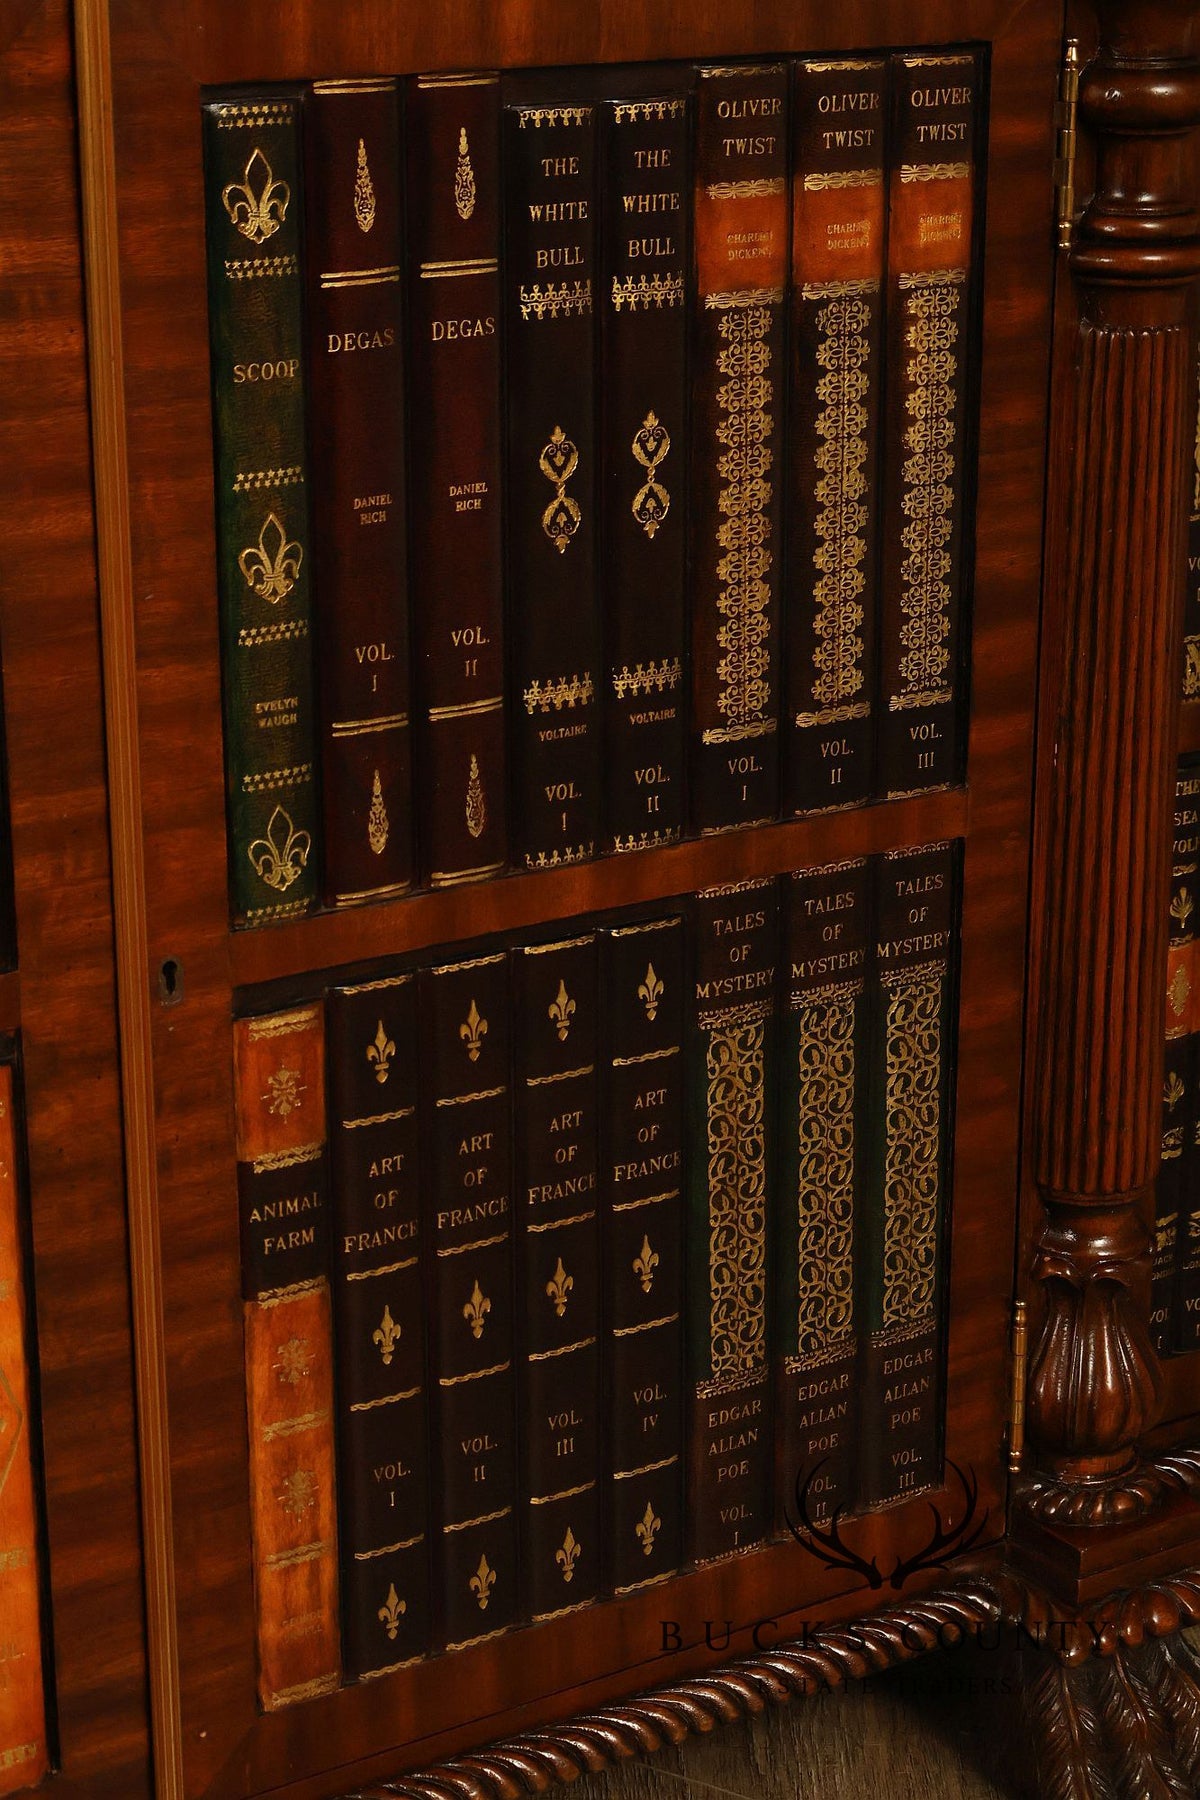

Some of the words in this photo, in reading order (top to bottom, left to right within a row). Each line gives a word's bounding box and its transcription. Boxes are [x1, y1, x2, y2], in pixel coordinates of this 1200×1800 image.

[818, 92, 879, 113] OLIVER
[911, 87, 971, 108] OLIVER
[717, 98, 782, 118] OLIVER
[823, 129, 874, 150] TWIST
[917, 123, 966, 143] TWIST
[723, 137, 775, 156] TWIST
[541, 157, 579, 177] THE
[634, 149, 671, 169] THE
[529, 201, 588, 222] WHITE
[623, 192, 680, 213] WHITE
[535, 246, 584, 269] BULL
[628, 237, 674, 258] BULL
[432, 317, 495, 341] DEGAS
[328, 329, 395, 352] DEGAS
[233, 359, 299, 383] SCOOP
[449, 482, 488, 497] DANIEL
[354, 493, 392, 509] DANIEL
[455, 498, 481, 512] RICH
[359, 510, 387, 525] RICH
[451, 626, 491, 647] VOL.
[355, 643, 395, 664] VOL.
[465, 658, 478, 677] II
[372, 674, 378, 692] I
[629, 707, 676, 726] VOLTAIRE
[538, 724, 587, 741] VOLTAIRE
[910, 724, 942, 742] VOL.
[820, 740, 854, 758] VOL.
[728, 757, 763, 776] VOL.
[917, 752, 935, 768] III
[635, 765, 671, 786] VOL.
[830, 769, 843, 785] II
[545, 782, 582, 802] VOL.
[741, 785, 748, 800] I
[647, 795, 660, 814] II
[561, 812, 568, 831] I
[895, 873, 944, 897] TALES
[804, 892, 855, 916] TALES
[713, 911, 766, 936] TALES
[908, 906, 929, 924] OF
[822, 924, 844, 943] OF
[729, 945, 749, 963] OF
[876, 929, 951, 959] MYSTERY
[792, 947, 867, 979] MYSTERY
[695, 968, 776, 1000] MYSTERY
[634, 1088, 667, 1111] ART
[549, 1110, 583, 1133] ART
[637, 1124, 660, 1143] OF
[458, 1132, 493, 1156] ART
[555, 1145, 578, 1165] OF
[368, 1155, 404, 1179] ART
[463, 1167, 488, 1187] OF
[528, 1173, 596, 1205] FRANCE
[249, 1192, 322, 1224] ANIMAL
[374, 1190, 399, 1210] OF
[437, 1195, 510, 1229] FRANCE
[263, 1227, 316, 1255] FARM
[343, 1219, 418, 1254] FRANCE
[883, 1349, 933, 1375] EDGAR
[633, 1385, 668, 1405] VOL.
[798, 1374, 849, 1401] EDGAR
[884, 1376, 930, 1404] ALLAN
[547, 1410, 583, 1430] VOL.
[642, 1414, 659, 1432] IV
[708, 1400, 762, 1428] EDGAR
[799, 1402, 848, 1428] ALLAN
[891, 1408, 921, 1430] POE
[461, 1436, 498, 1455] VOL.
[557, 1438, 575, 1456] III
[708, 1431, 758, 1456] ALLAN
[808, 1433, 839, 1455] POE
[891, 1448, 922, 1467] VOL.
[373, 1463, 412, 1483] VOL.
[473, 1465, 487, 1482] II
[717, 1460, 750, 1482] POE
[899, 1472, 915, 1489] III
[389, 1491, 396, 1507] I
[720, 1505, 753, 1523] VOL.
[816, 1502, 826, 1517] II
[733, 1532, 739, 1545] I
